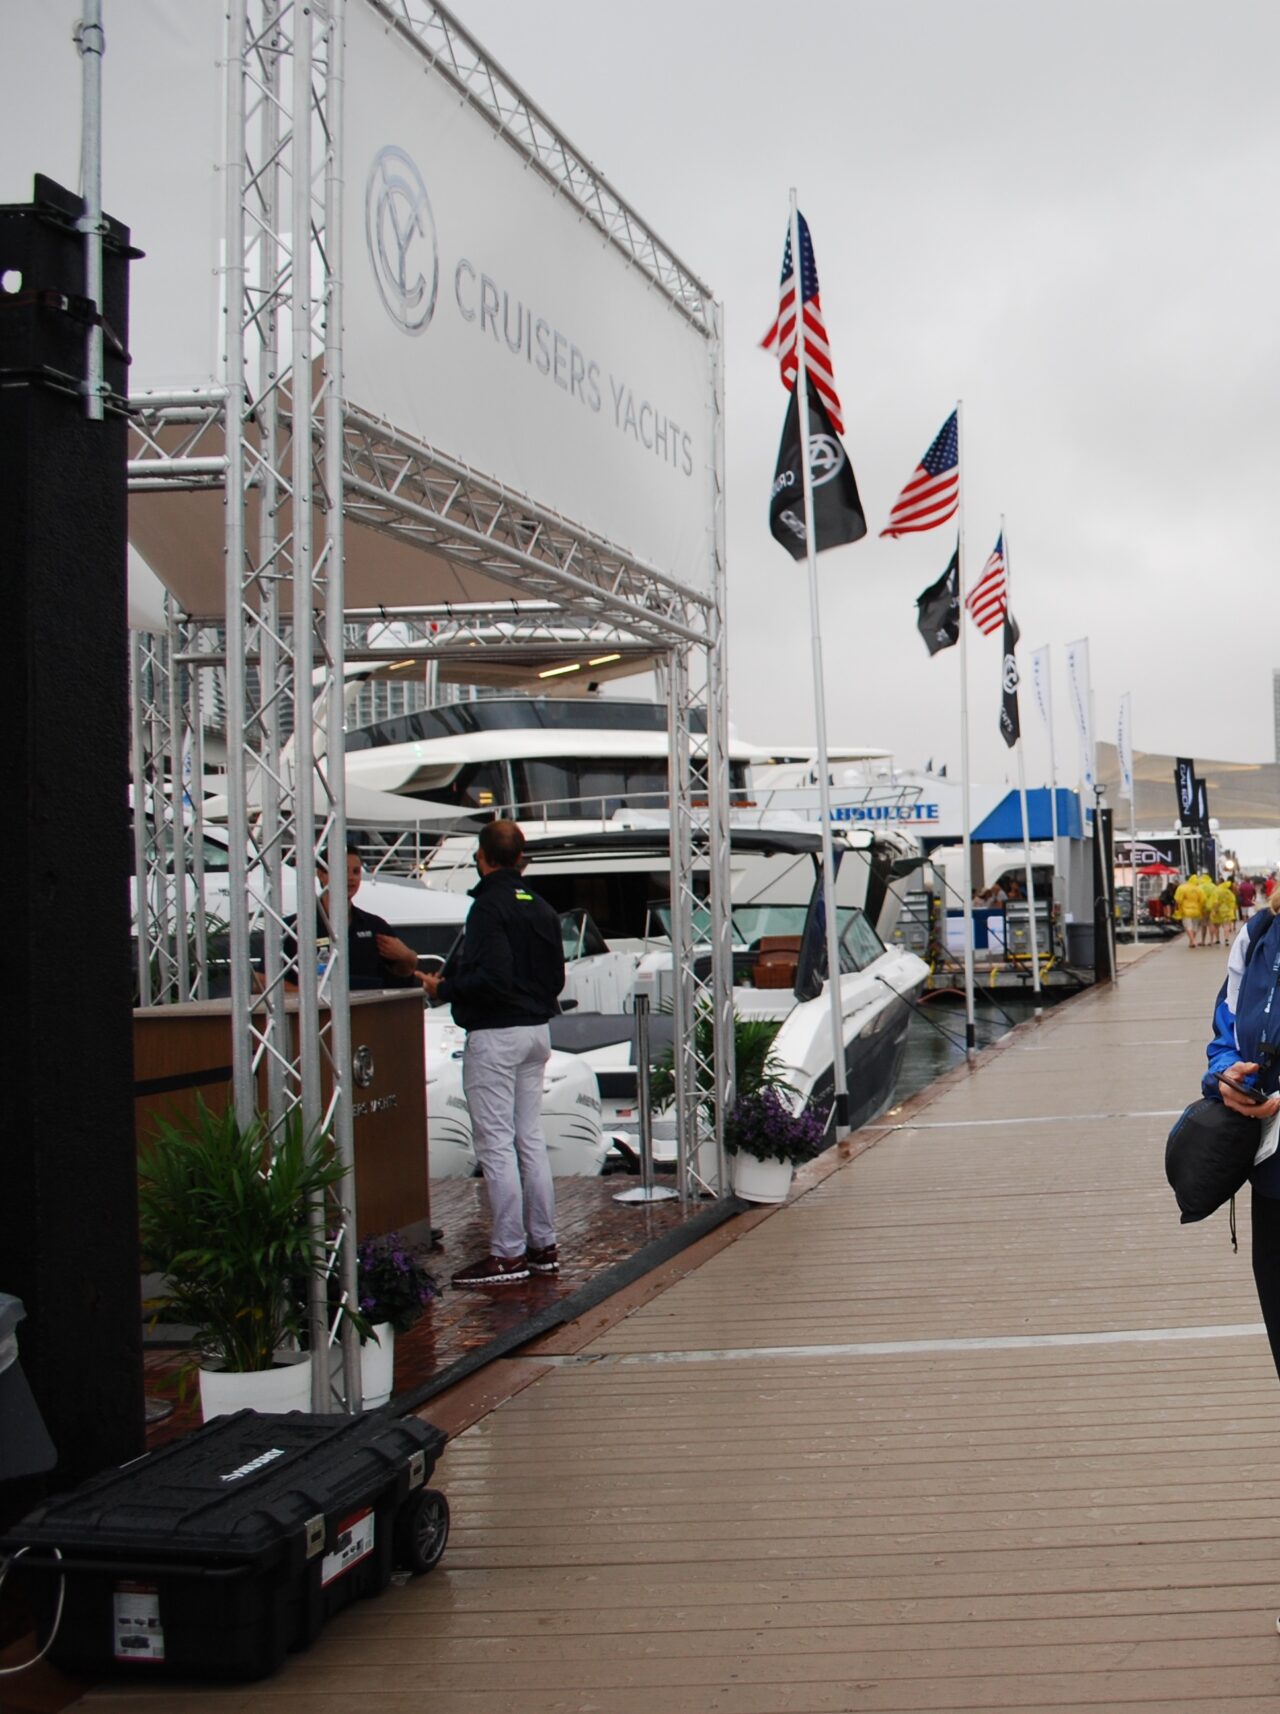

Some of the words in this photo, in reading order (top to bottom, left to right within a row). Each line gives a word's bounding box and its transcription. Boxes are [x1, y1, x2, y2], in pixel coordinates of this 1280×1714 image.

[455, 258, 601, 413] CRUISERS
[609, 374, 694, 477] YACHTS
[1113, 851, 1172, 863] LEON
